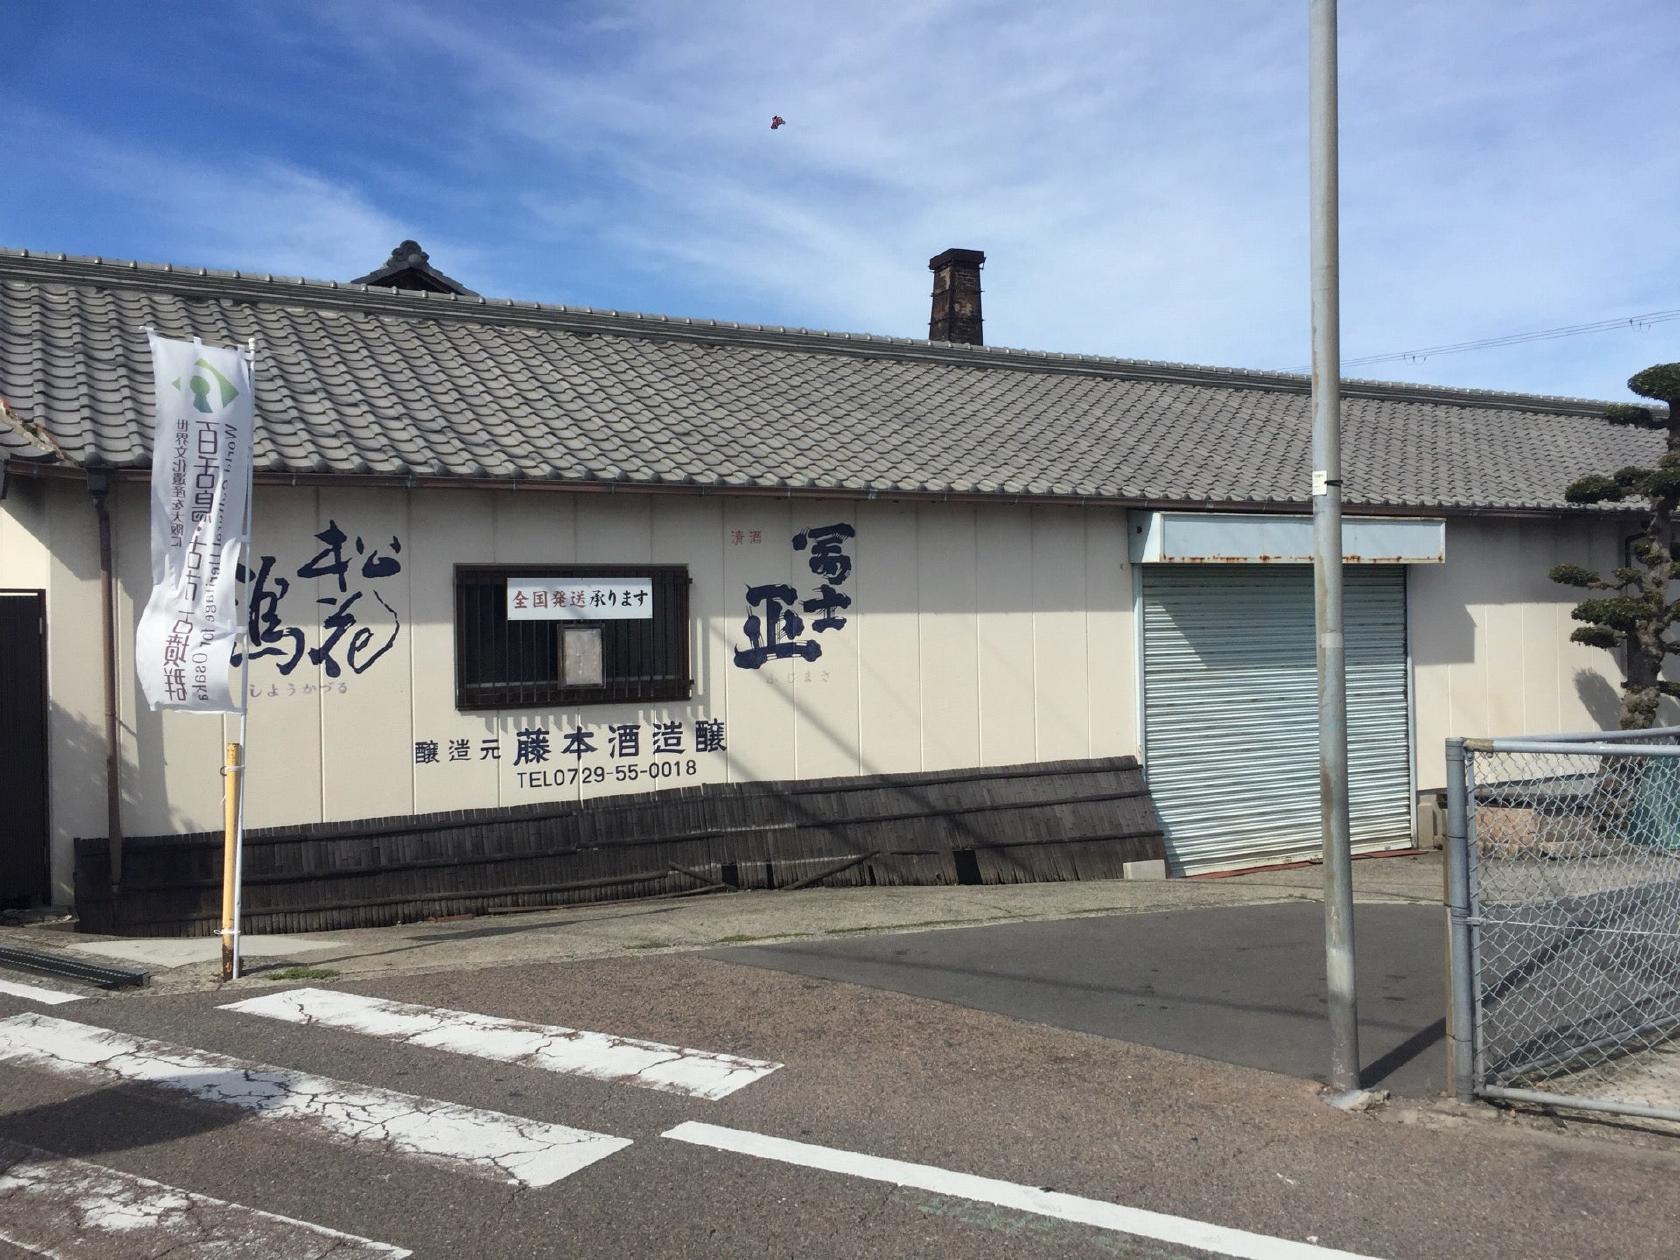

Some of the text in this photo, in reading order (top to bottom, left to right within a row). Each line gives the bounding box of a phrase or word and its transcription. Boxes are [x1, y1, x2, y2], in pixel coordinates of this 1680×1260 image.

[512, 588, 649, 610] 全国発送承ります
[517, 759, 698, 789] TEL0729-55-0018
